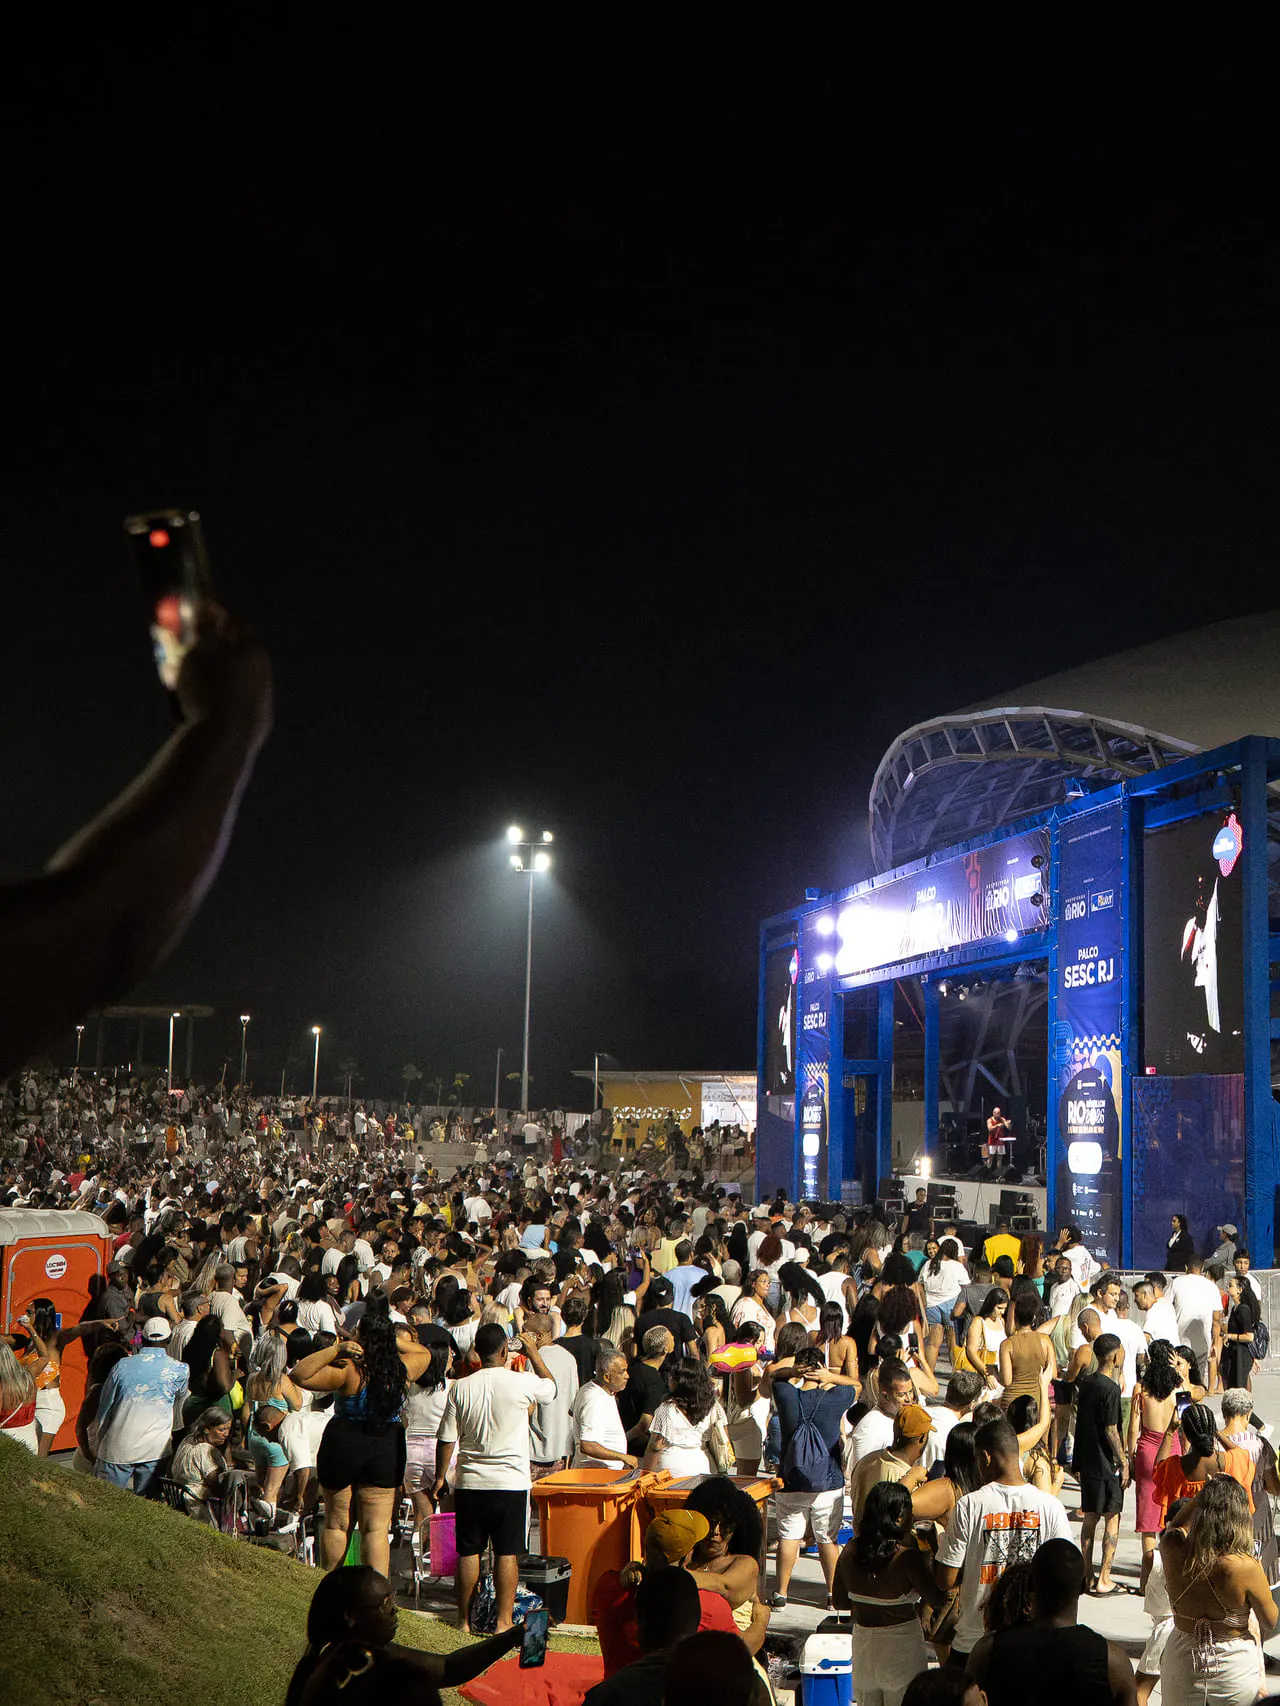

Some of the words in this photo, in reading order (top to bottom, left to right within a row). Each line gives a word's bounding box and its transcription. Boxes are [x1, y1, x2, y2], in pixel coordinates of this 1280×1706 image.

[1072, 900, 1086, 919] RIO
[1078, 945, 1099, 961] PALCO
[1064, 961, 1096, 988] SESC
[1097, 958, 1114, 984] RJ
[803, 1013, 818, 1030] SESC
[818, 1011, 827, 1028] RJ
[1068, 1100, 1086, 1124] RIO
